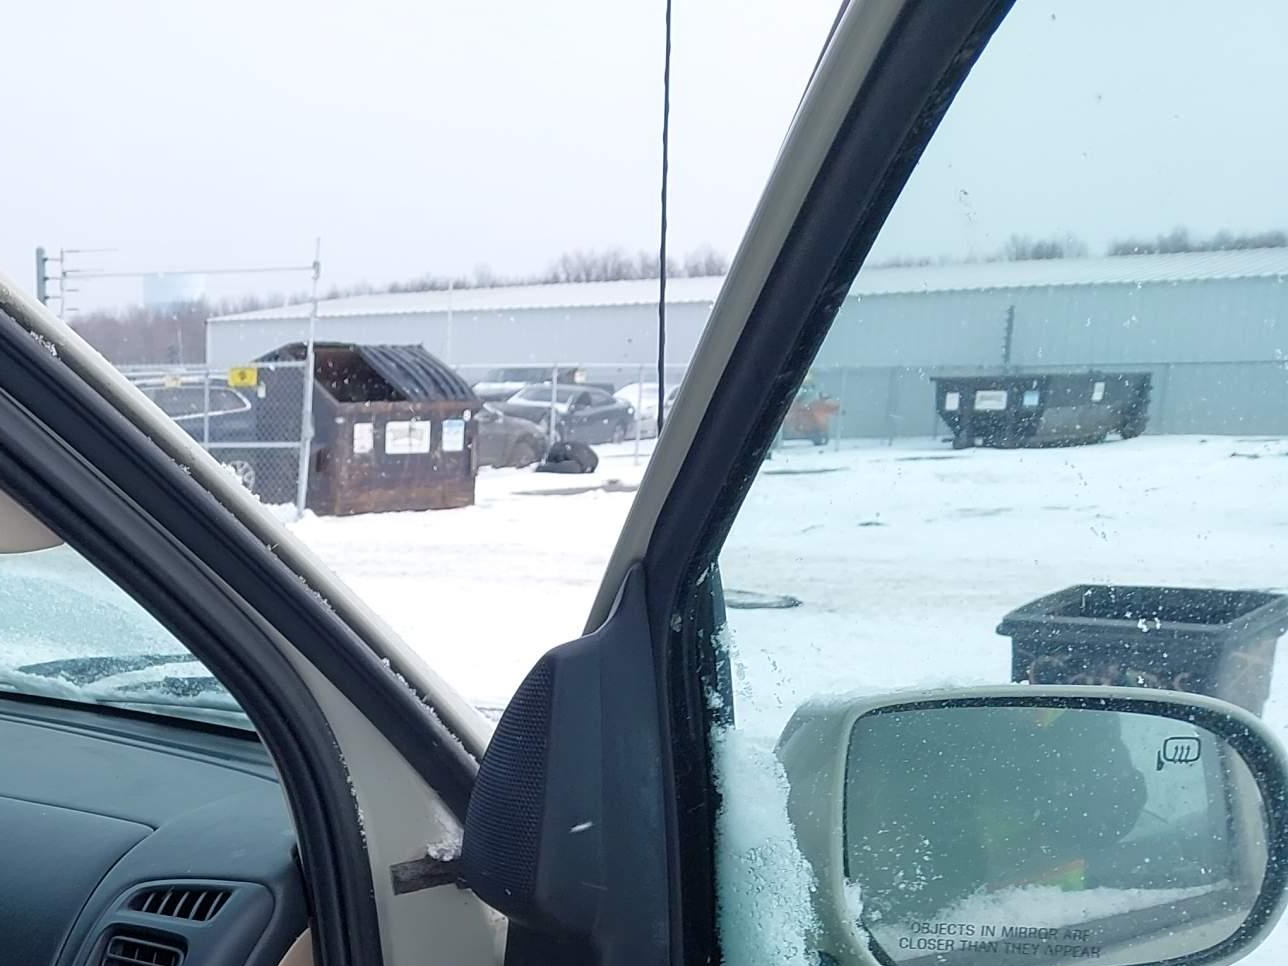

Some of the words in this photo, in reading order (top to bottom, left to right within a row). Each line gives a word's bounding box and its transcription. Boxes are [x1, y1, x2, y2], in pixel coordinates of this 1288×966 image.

[912, 922, 976, 936] OBJECTS
[980, 925, 997, 937] IN
[1001, 925, 1058, 940] MIRROR
[899, 937, 955, 952] CLOSER
[960, 940, 998, 953] THAN
[1004, 942, 1040, 956] THEY
[1044, 944, 1102, 959] APPEAR
